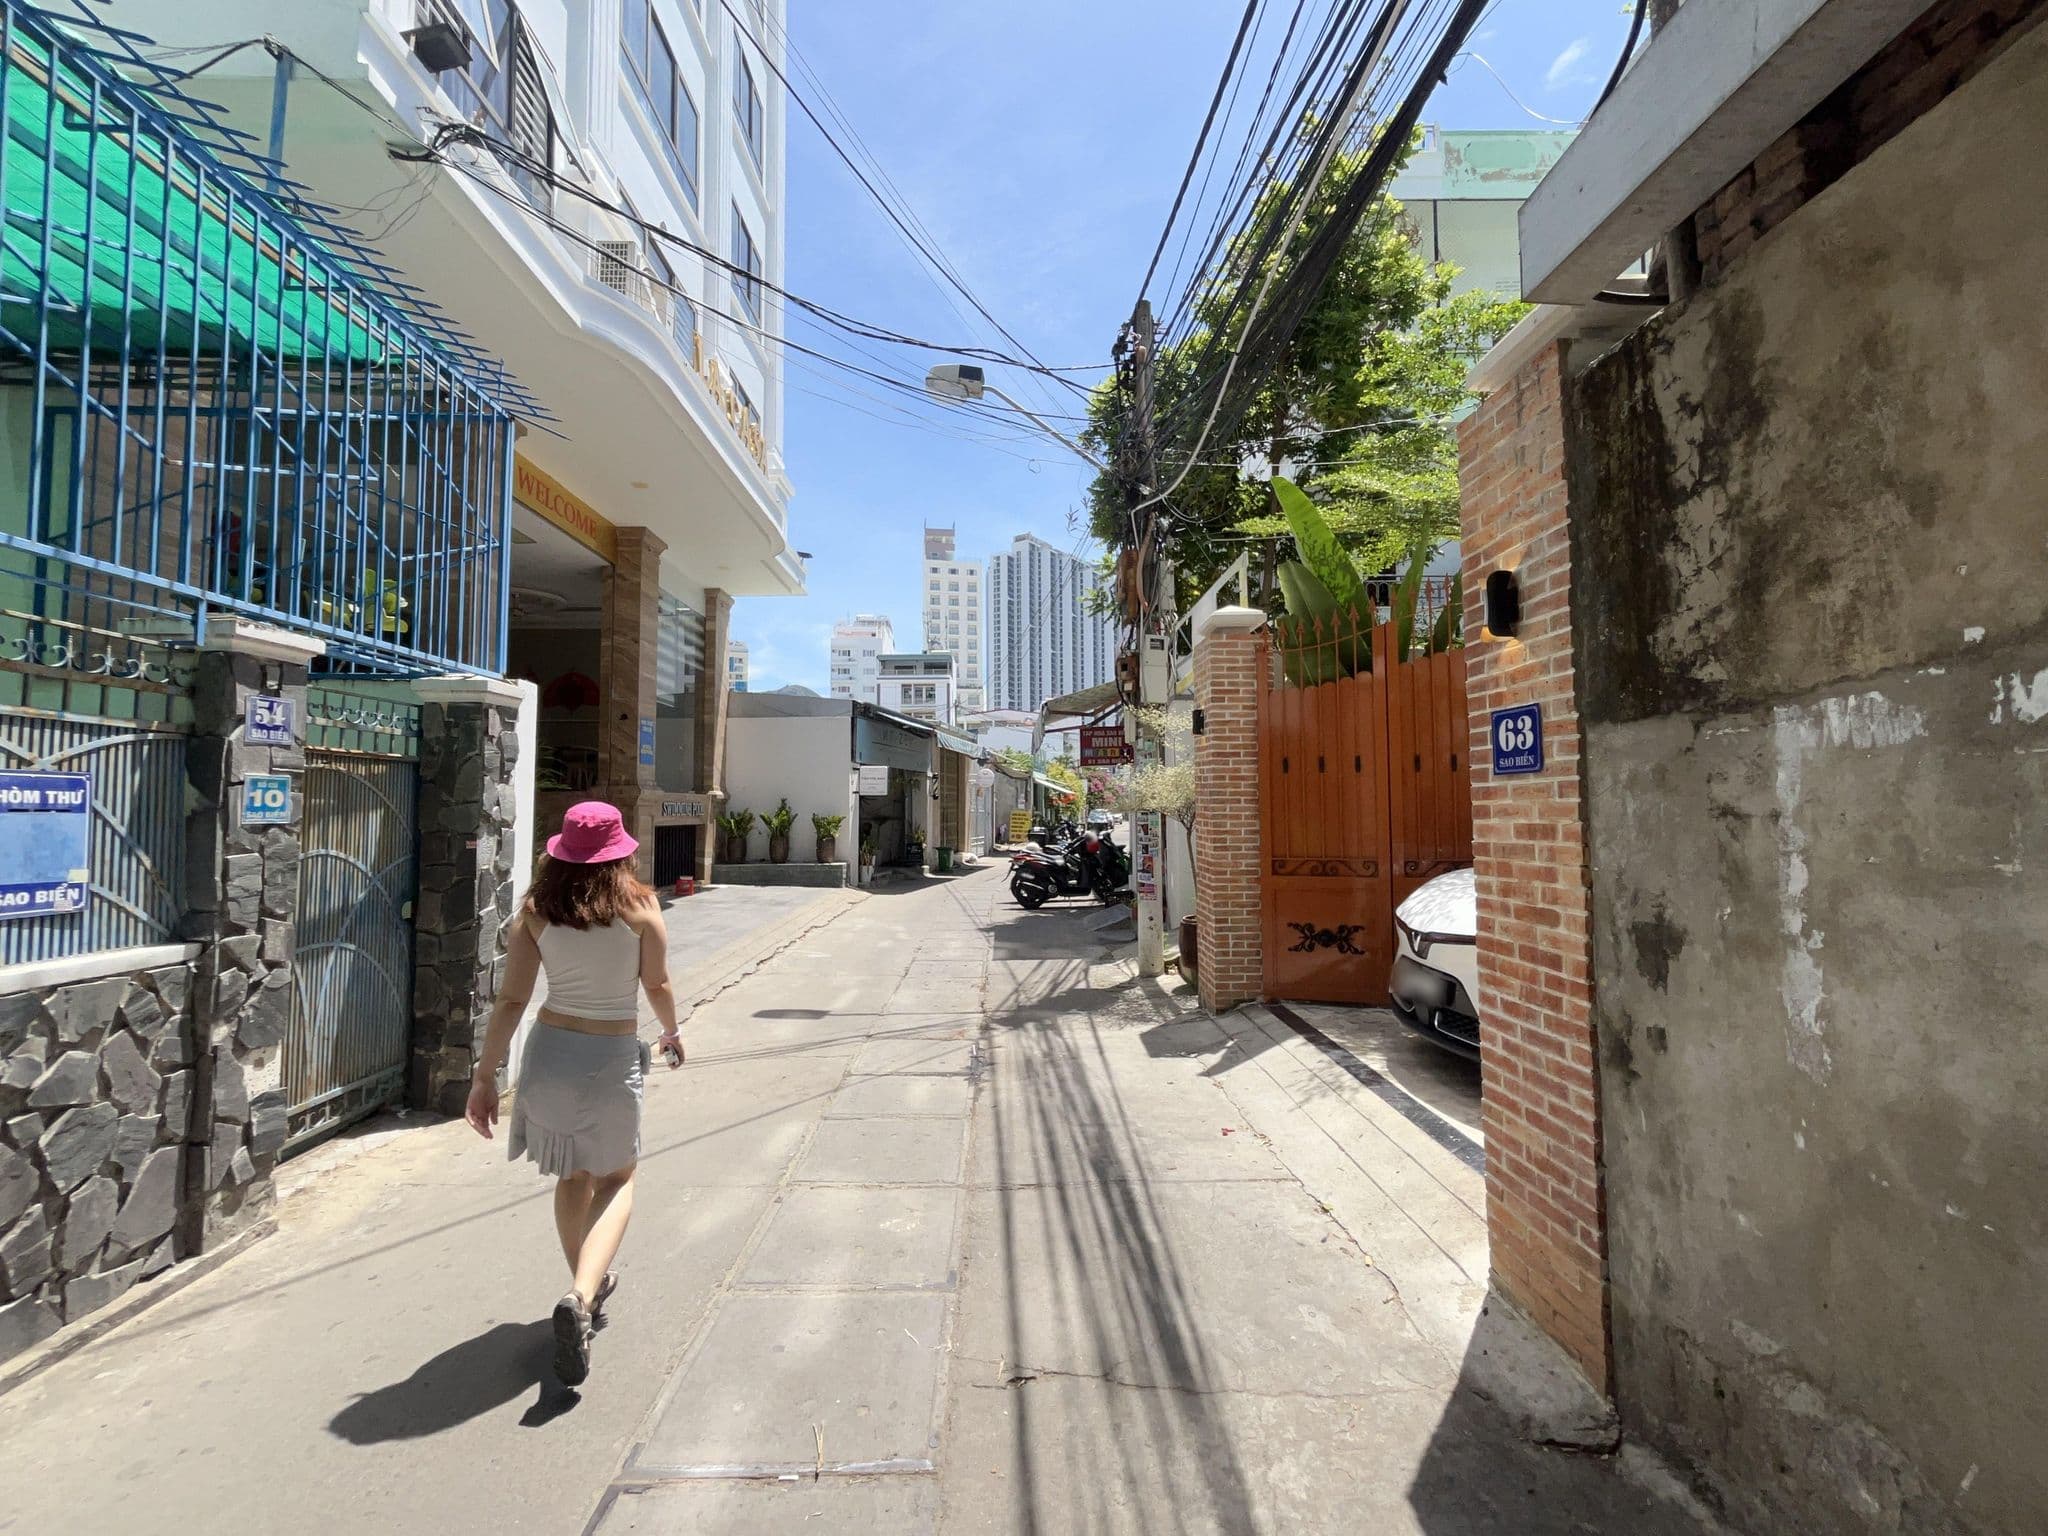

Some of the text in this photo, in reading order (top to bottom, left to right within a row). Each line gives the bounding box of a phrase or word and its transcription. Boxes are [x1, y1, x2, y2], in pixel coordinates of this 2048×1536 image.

[518, 465, 598, 539] WELCOME
[255, 700, 286, 726] 54
[251, 728, 268, 739] SAO
[1092, 737, 1122, 747] MINI
[1499, 715, 1534, 752] 63
[1499, 757, 1514, 768] SAO
[45, 789, 85, 805] THƯ
[250, 789, 285, 808] 10
[0, 882, 80, 907] AO BIỂN
